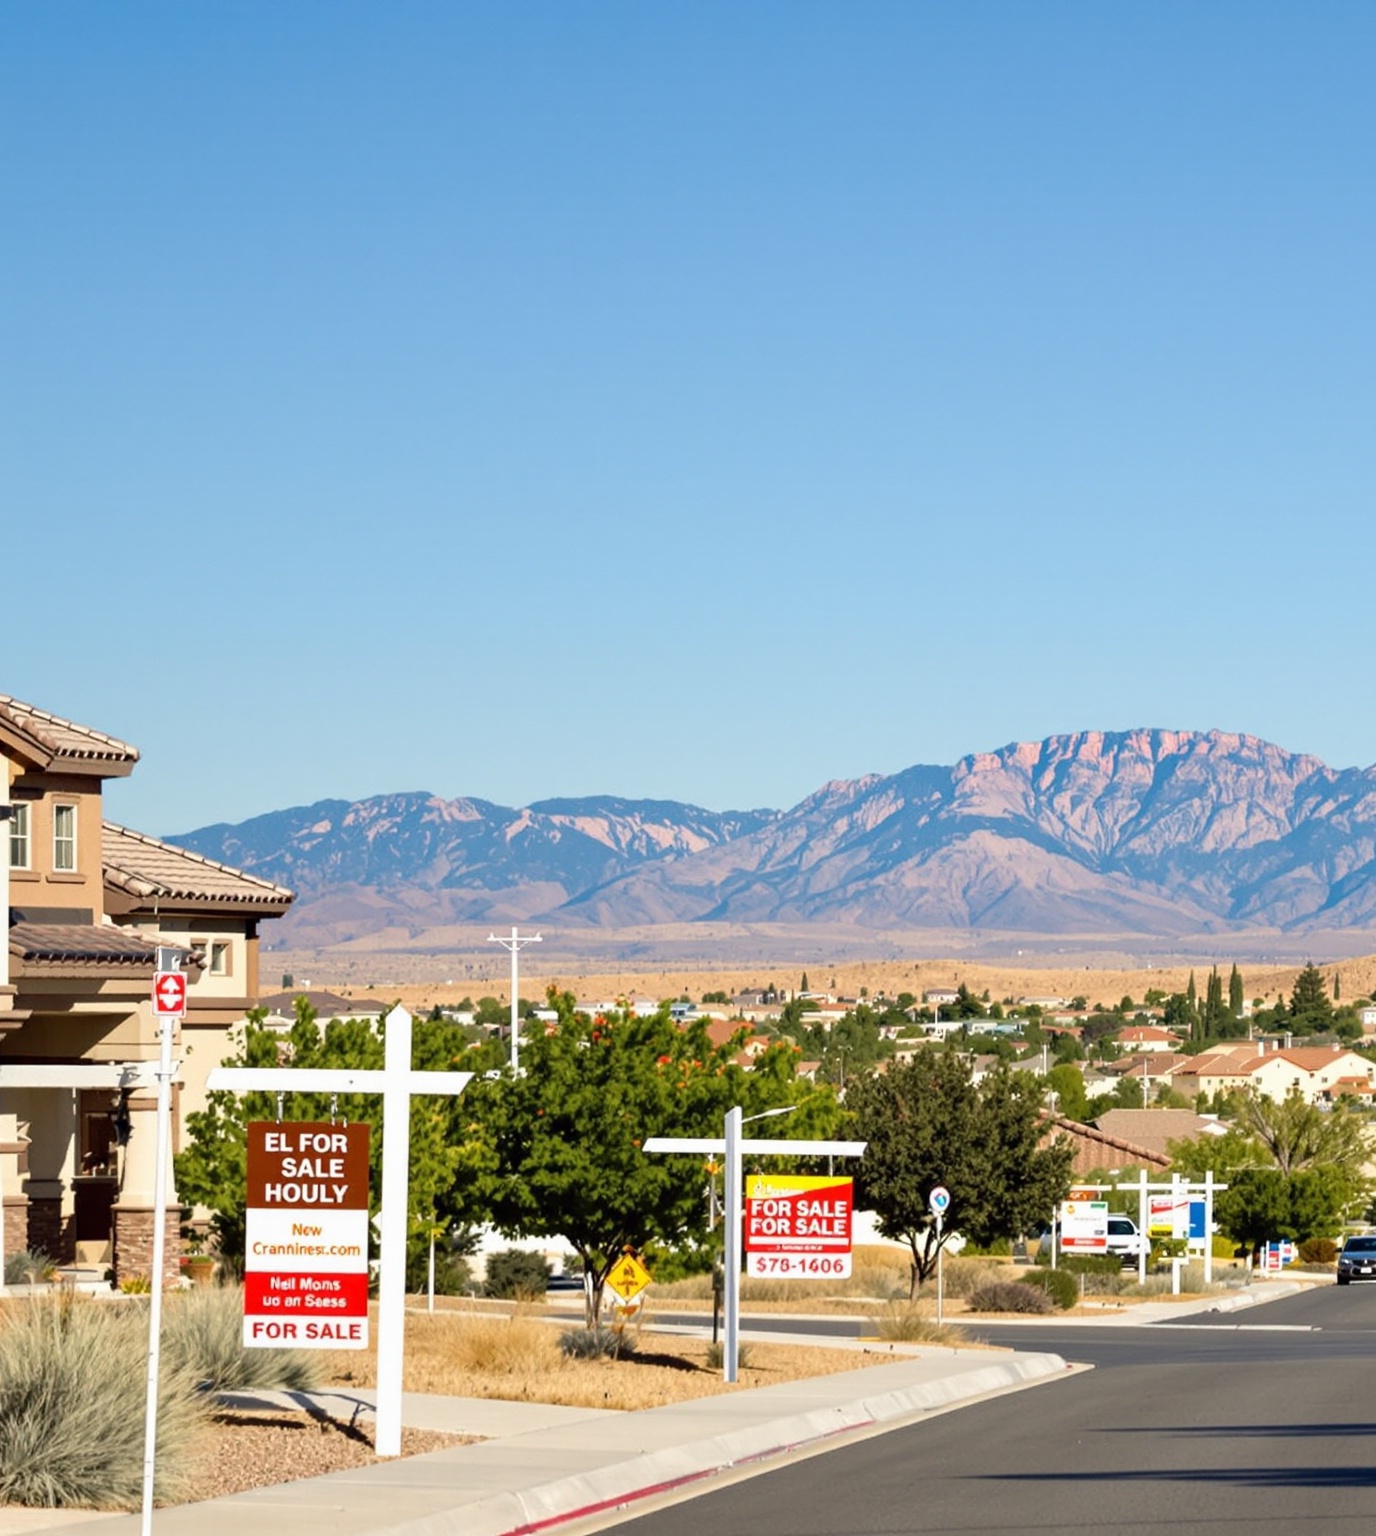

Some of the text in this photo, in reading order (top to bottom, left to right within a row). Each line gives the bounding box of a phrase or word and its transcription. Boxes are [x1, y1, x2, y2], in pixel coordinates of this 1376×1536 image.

[265, 1133, 348, 1153] EL FOR
[281, 1157, 344, 1178] SALE
[265, 1183, 348, 1203] HOULY
[751, 1199, 847, 1217] FOR SALE
[750, 1217, 846, 1235] FOR SALE
[252, 1322, 361, 1340] FOR SALE
